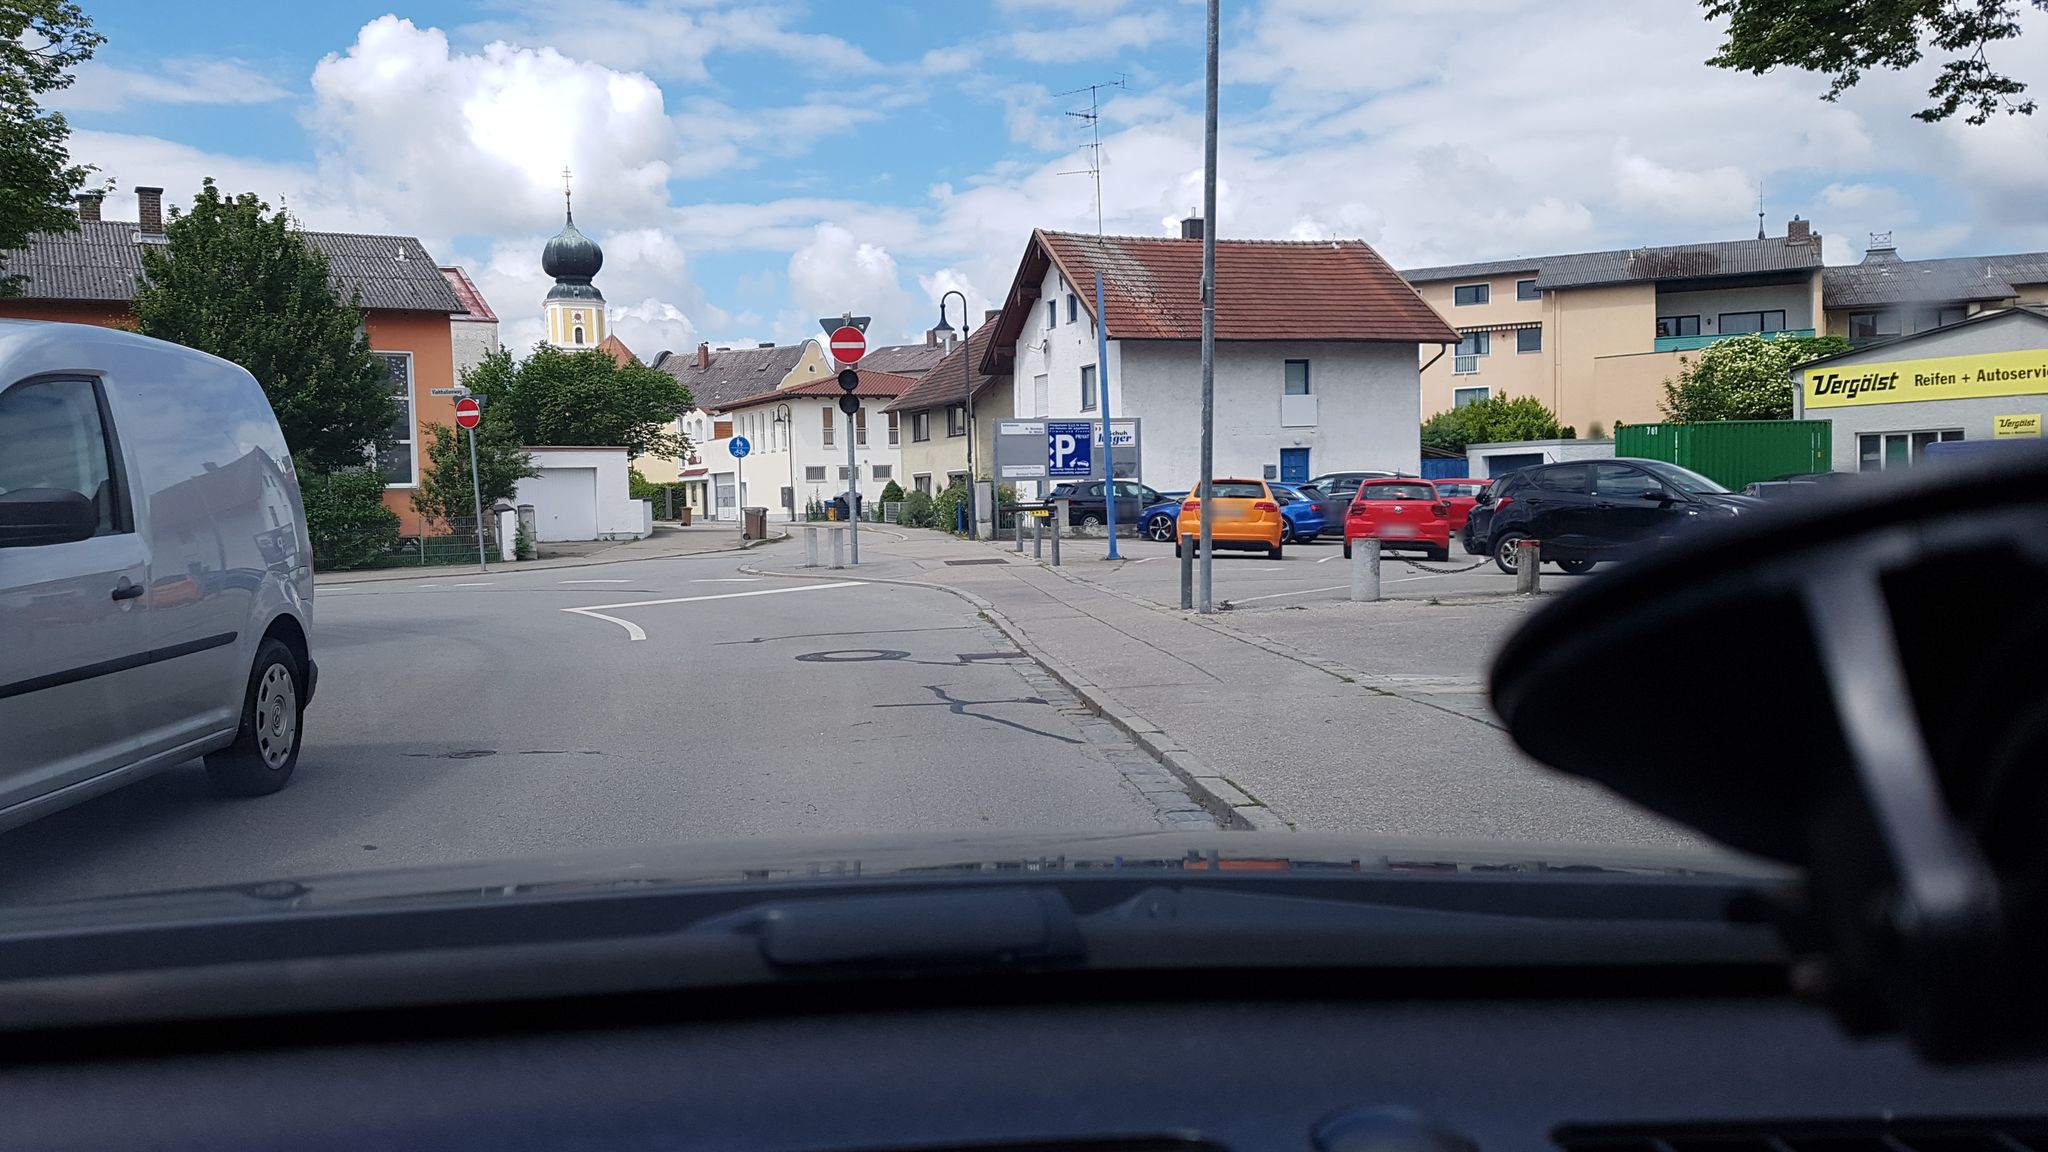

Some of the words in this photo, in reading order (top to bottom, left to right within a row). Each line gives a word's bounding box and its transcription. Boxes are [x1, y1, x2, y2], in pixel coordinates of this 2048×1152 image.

[1812, 372, 1899, 399] Vergölst
[1914, 372, 1956, 387] Reifen
[1961, 373, 1971, 383] +
[1055, 434, 1076, 468] P
